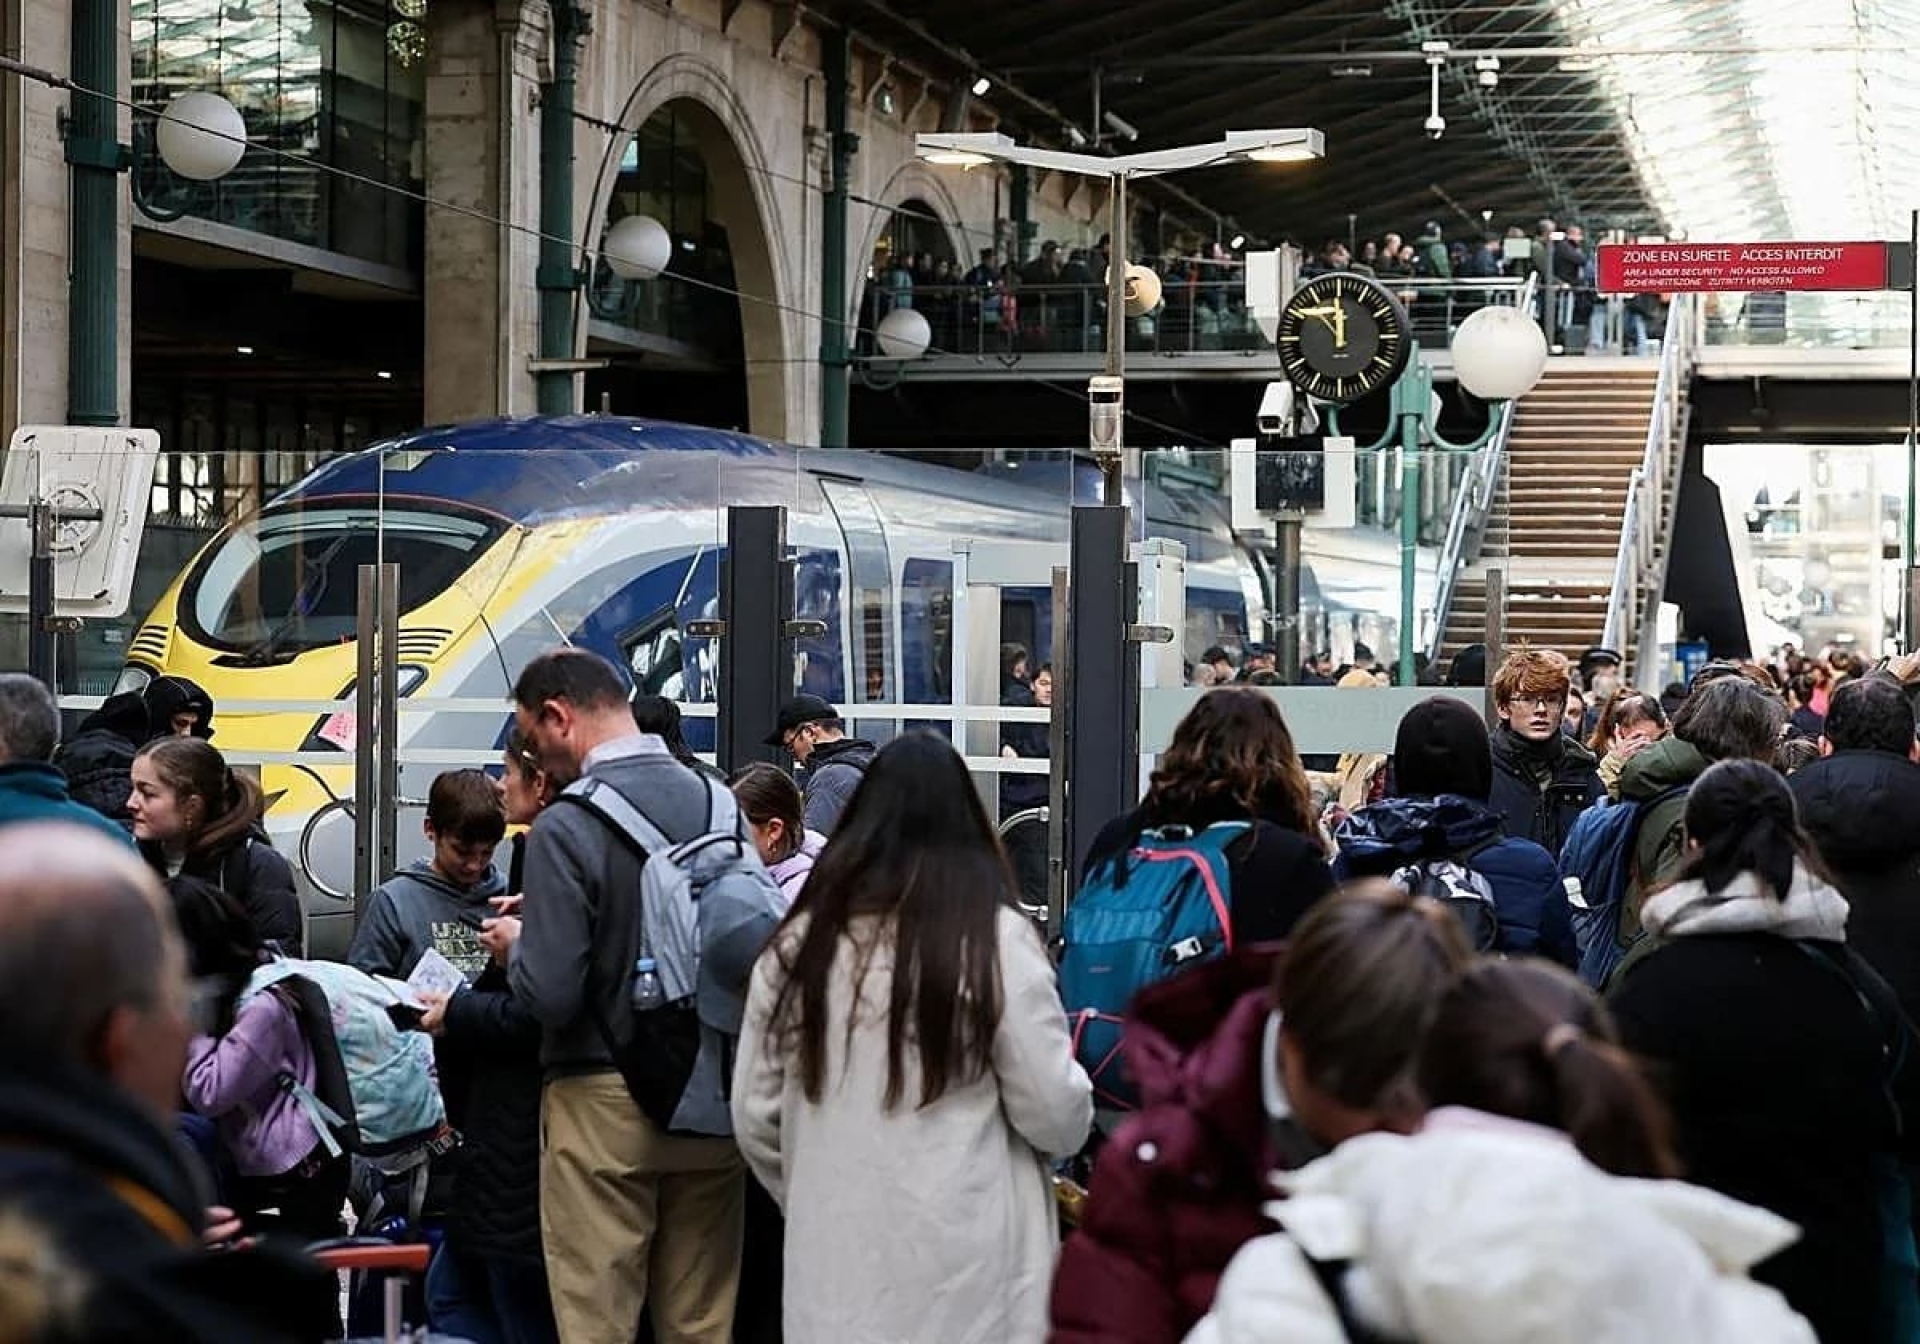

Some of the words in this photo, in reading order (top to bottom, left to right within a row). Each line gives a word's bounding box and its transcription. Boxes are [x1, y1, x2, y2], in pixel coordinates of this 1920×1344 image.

[1623, 251, 1659, 263] ZONE
[1661, 251, 1679, 262] EN
[1680, 250, 1732, 262] SURETE
[1740, 249, 1783, 261] ACCES
[1785, 248, 1844, 260] INTERDIT
[1623, 268, 1647, 276] AREA
[1649, 268, 1680, 276] UNDER
[1681, 267, 1724, 276] SECURITY
[1730, 267, 1745, 275] NO
[1746, 267, 1780, 275] ACCESS
[1781, 266, 1825, 274] ALLOWED
[1746, 276, 1793, 285] VERBOTEN
